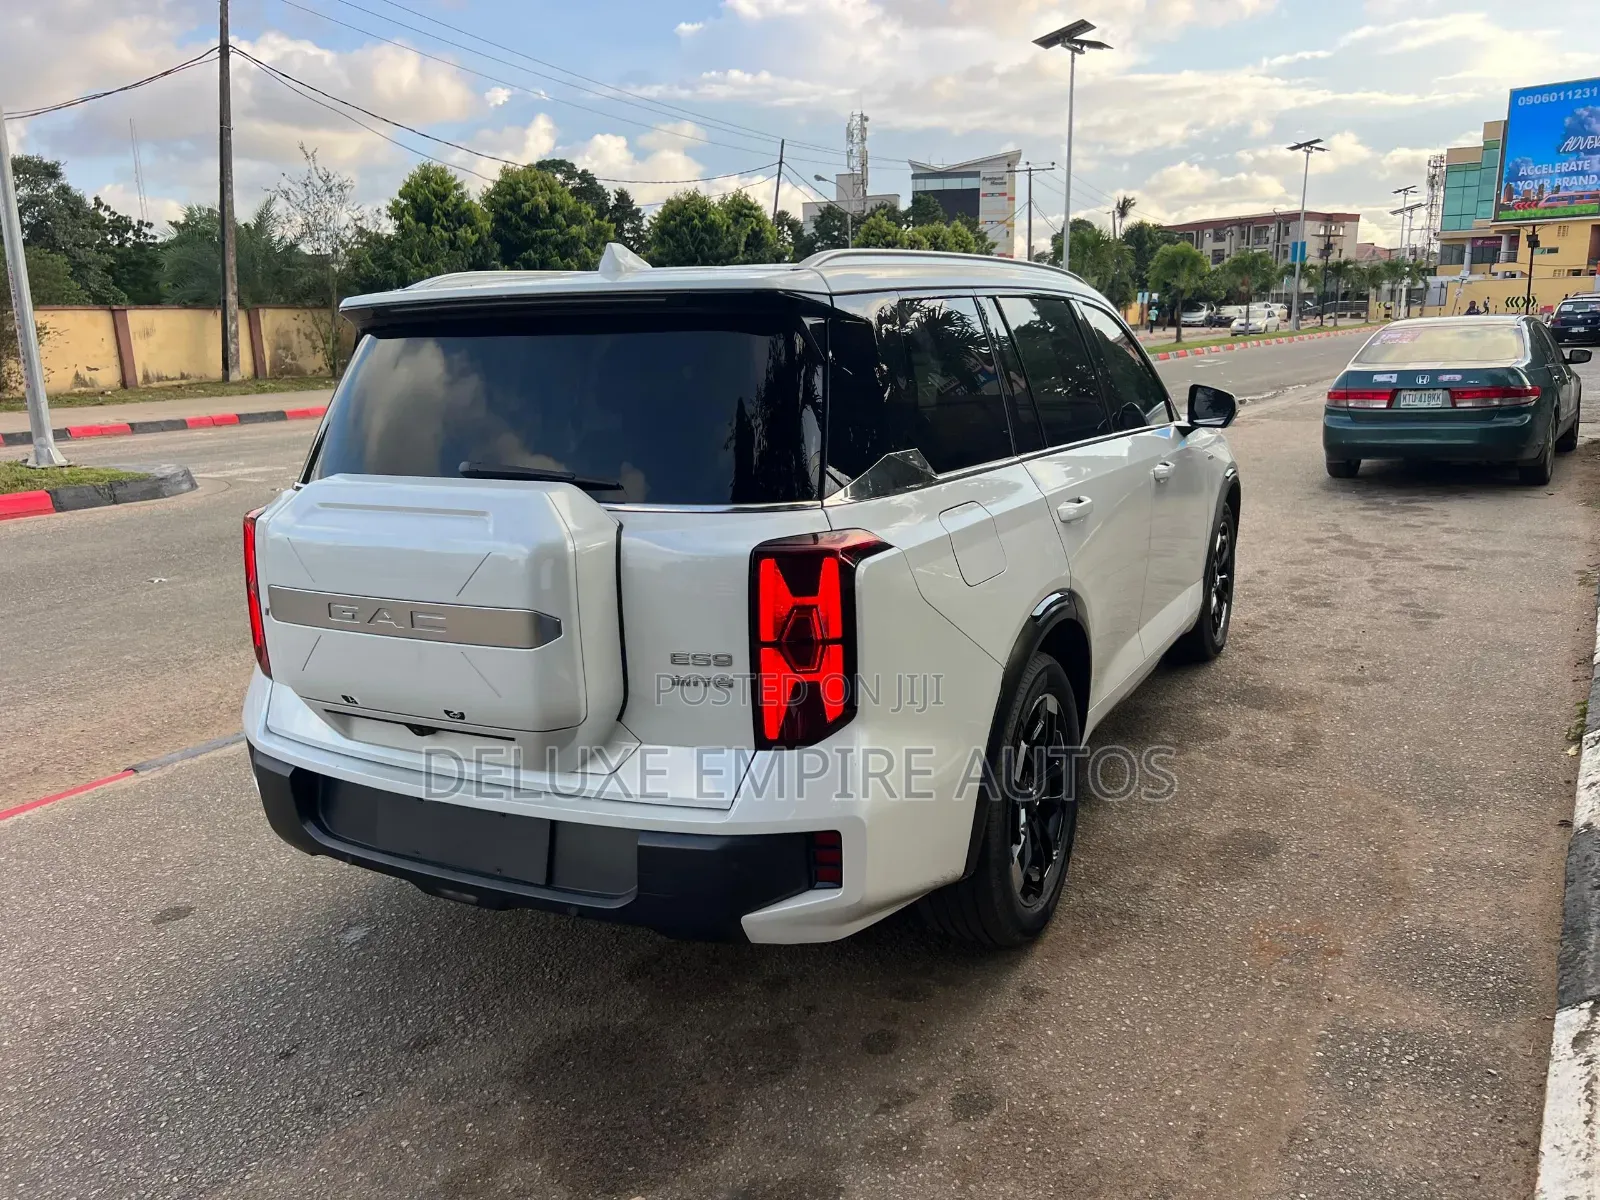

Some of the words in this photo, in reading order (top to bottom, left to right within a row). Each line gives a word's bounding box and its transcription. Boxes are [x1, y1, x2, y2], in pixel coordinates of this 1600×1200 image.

[1518, 87, 1598, 106] 0906011231
[1518, 160, 1591, 176] ACCELERATE
[1517, 178, 1551, 190] YOUR
[327, 602, 447, 633] GAC
[670, 651, 733, 667] ES9
